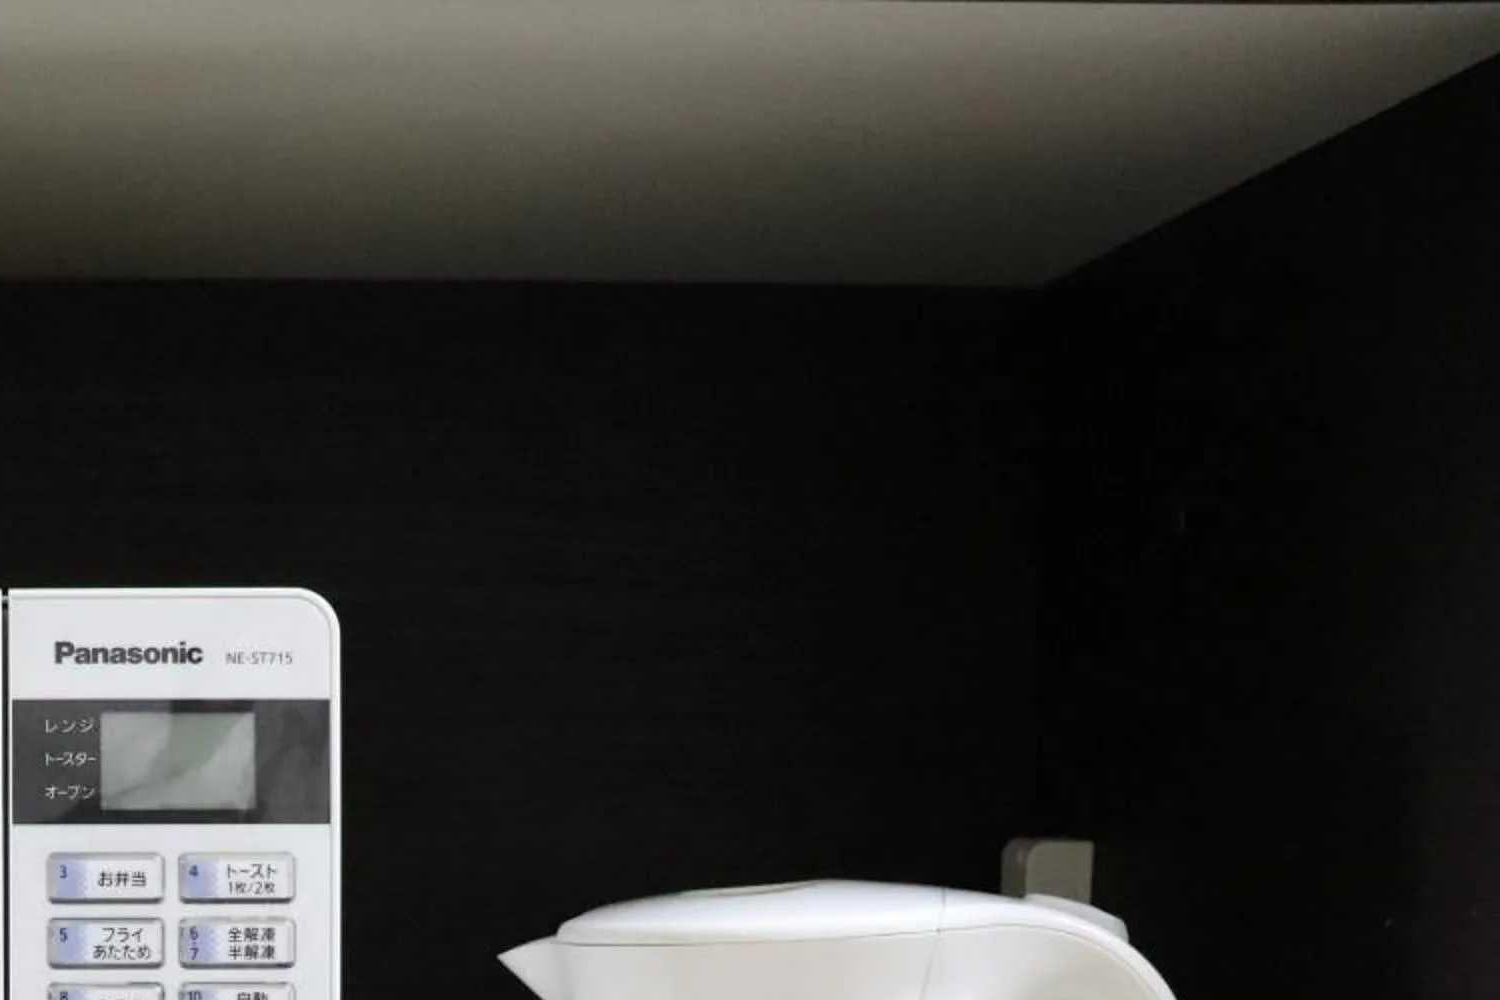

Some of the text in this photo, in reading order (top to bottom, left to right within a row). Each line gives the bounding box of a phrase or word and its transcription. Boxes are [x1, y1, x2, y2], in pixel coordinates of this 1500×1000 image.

[54, 641, 203, 664] Panasonic
[225, 652, 293, 665] NE-ST715
[45, 719, 93, 733] レンジ
[45, 752, 97, 766] トースター
[45, 785, 95, 799] オープン
[59, 865, 68, 879] 3
[189, 865, 199, 877] 4
[227, 863, 277, 878] トースト
[97, 870, 147, 888] お弁当
[59, 928, 68, 942] 5
[102, 927, 144, 943] フライ
[189, 927, 199, 941] 6
[228, 927, 275, 942] 全解凍
[93, 945, 151, 960] あたため
[190, 949, 199, 960] 7
[228, 944, 275, 960] 半解凍
